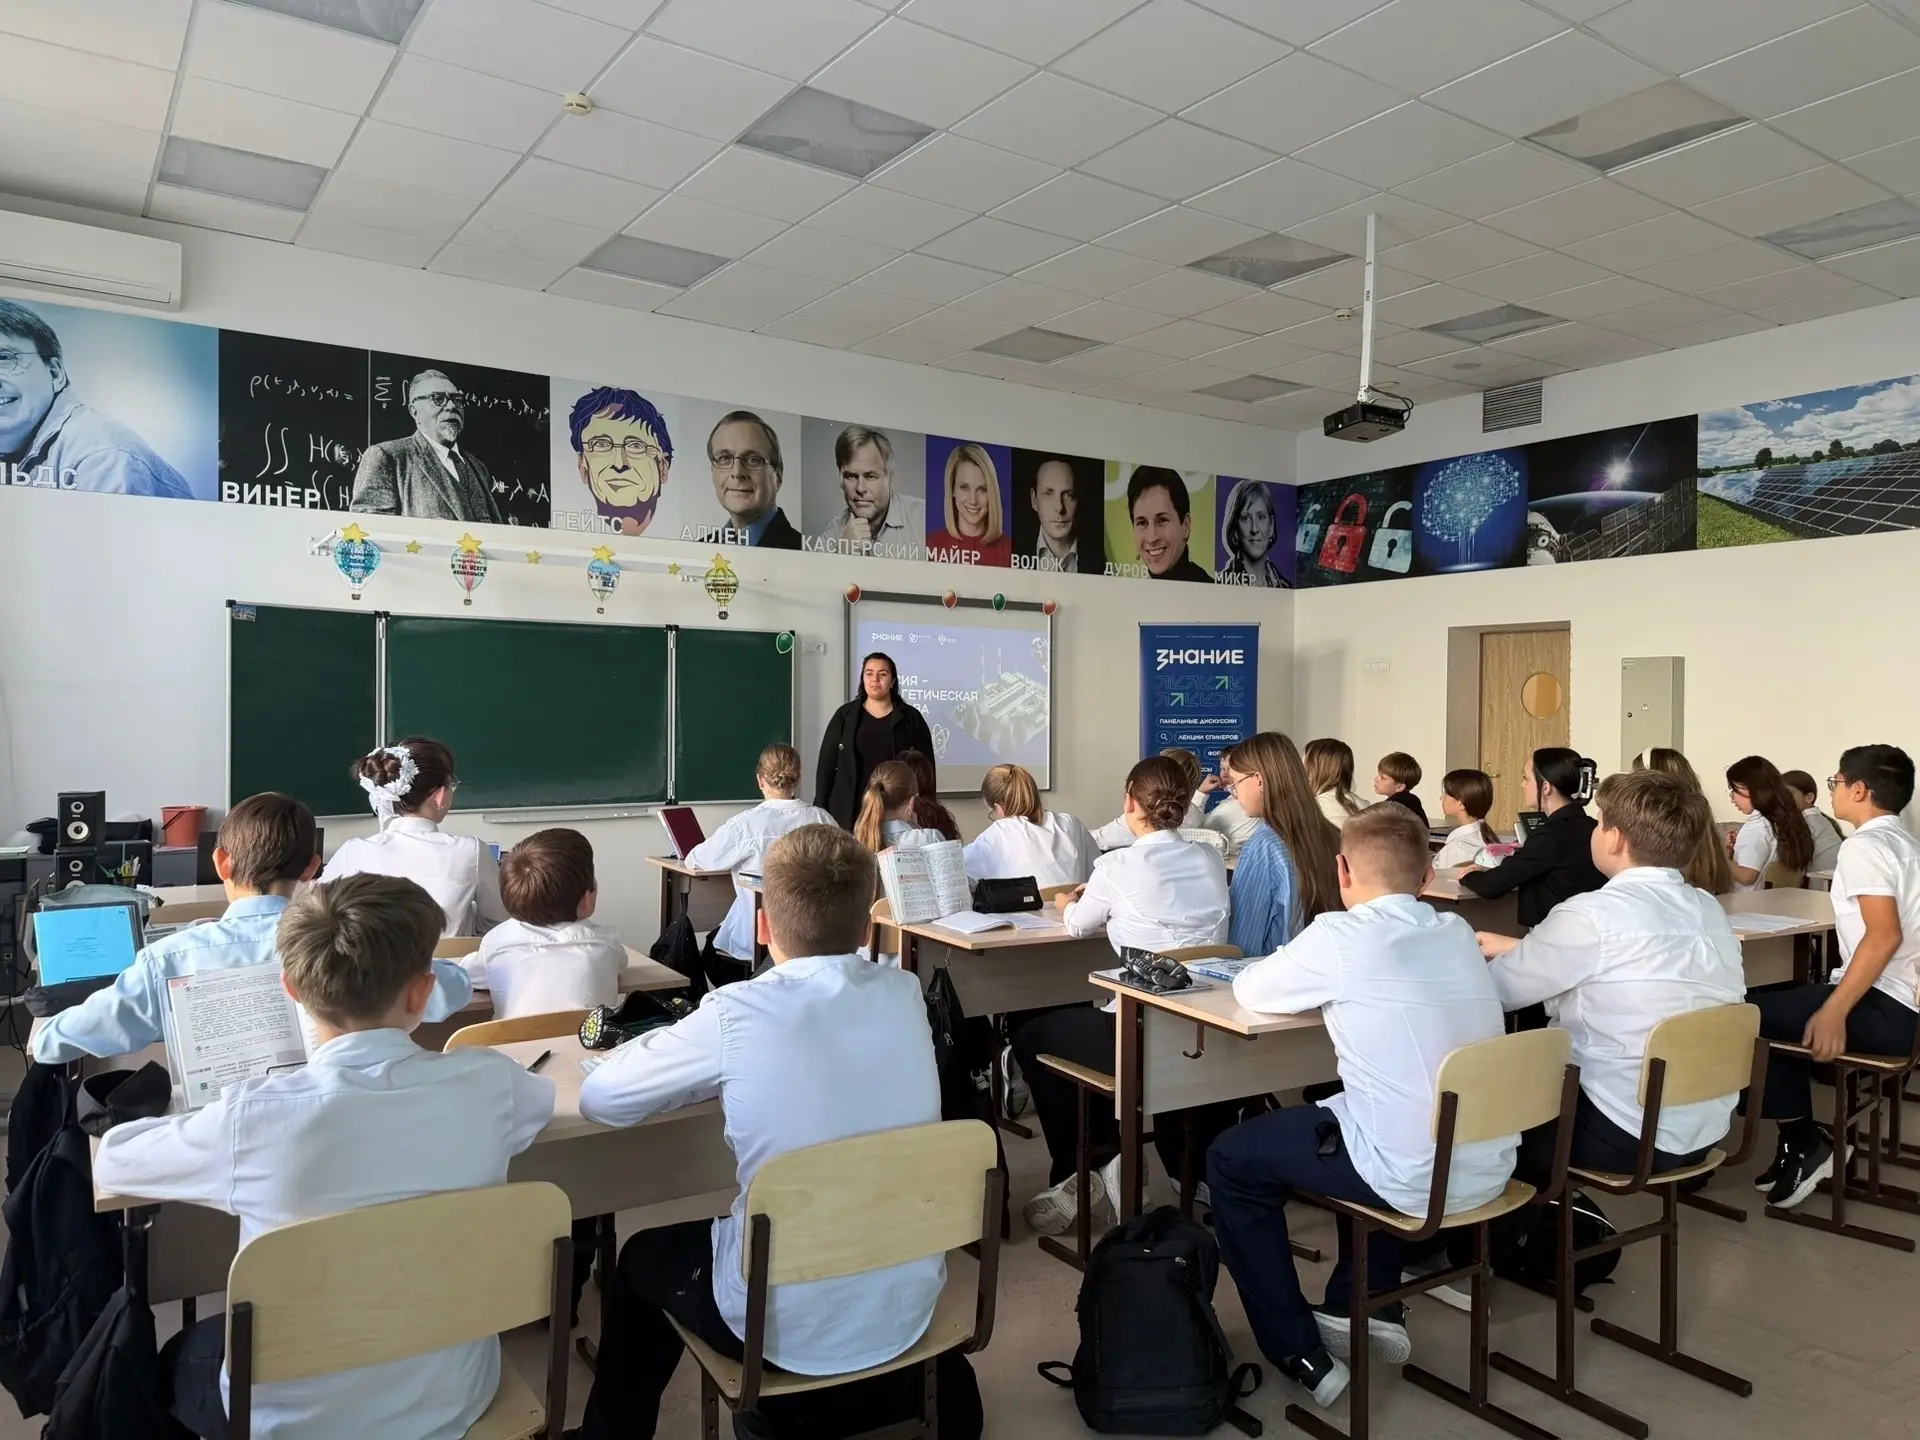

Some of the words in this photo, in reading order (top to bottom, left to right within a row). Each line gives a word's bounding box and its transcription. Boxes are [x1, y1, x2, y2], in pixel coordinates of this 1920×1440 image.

[222, 481, 321, 509] ВИНЕР
[551, 509, 624, 535] ГЕЙТС
[680, 524, 750, 546] АЛЛЕН
[801, 534, 919, 560] КАСПЕРСКИЙ
[925, 545, 981, 566] МАЙЕР
[1010, 553, 1064, 572] ВОЛОЖ
[1103, 561, 1149, 578] ДУРОВ
[1214, 570, 1257, 587] МИКЕР
